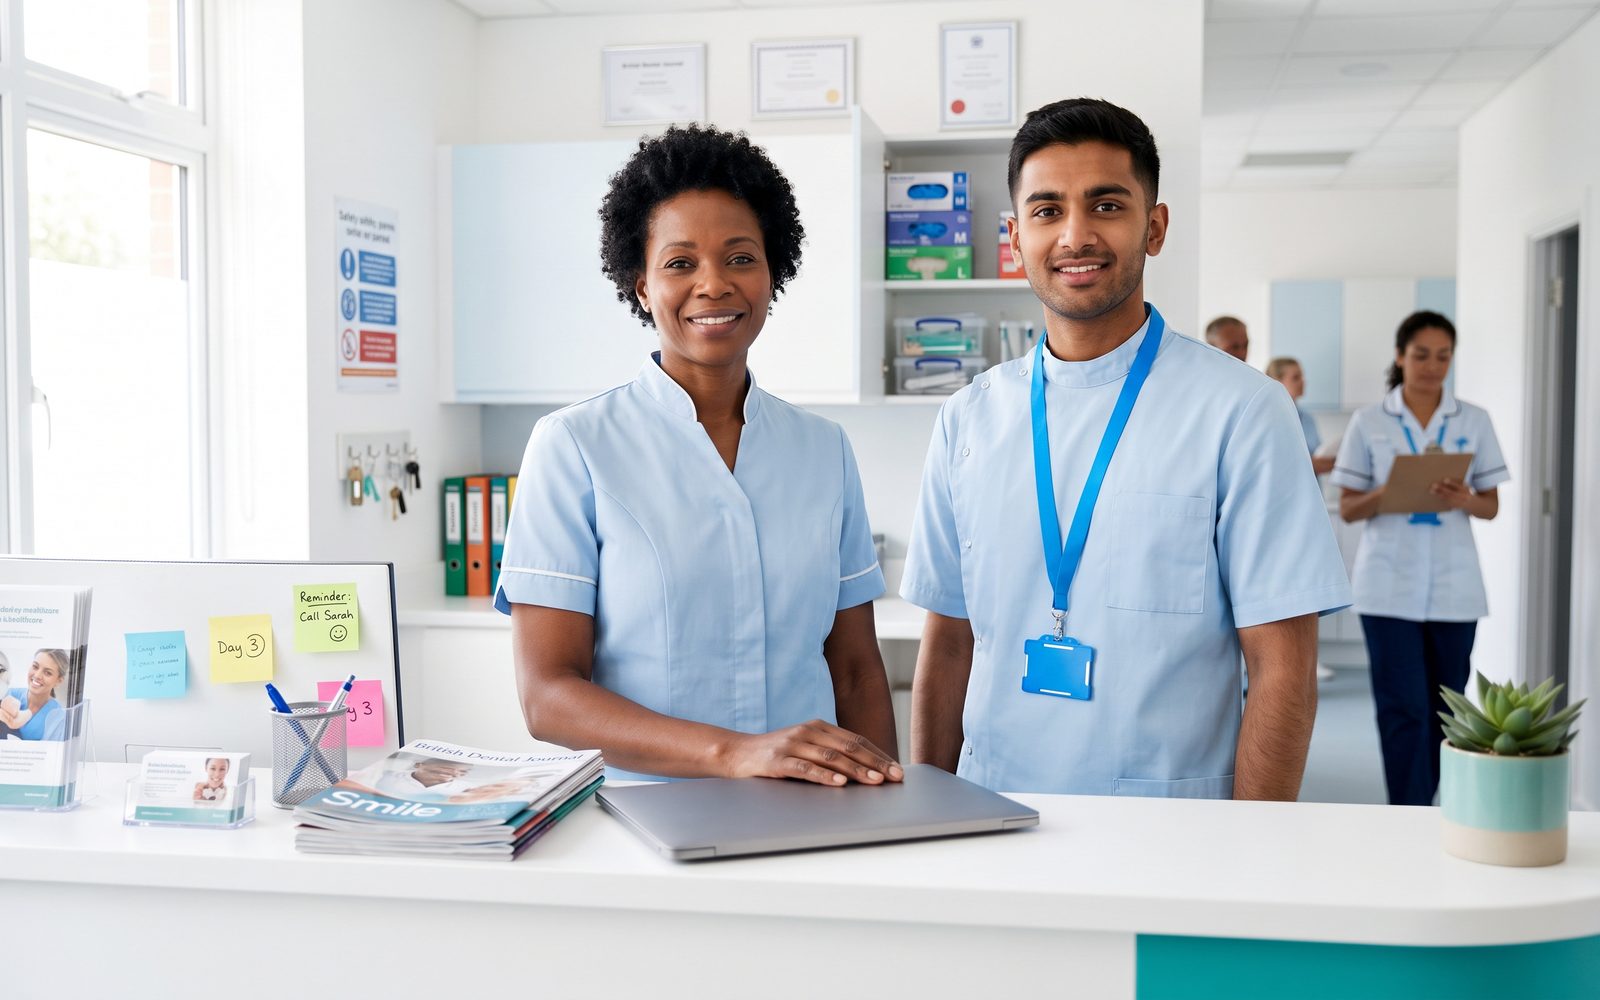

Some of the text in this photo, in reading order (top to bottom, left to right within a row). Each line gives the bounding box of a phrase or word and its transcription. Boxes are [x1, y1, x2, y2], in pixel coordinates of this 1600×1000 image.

[954, 232, 967, 244] M
[957, 267, 967, 279] L
[300, 590, 351, 603] Reminder:
[300, 609, 354, 622] Call Sarah
[217, 638, 259, 659] Day 3
[362, 701, 373, 715] 3
[414, 741, 585, 763] British Dental Journal
[321, 791, 442, 817] Smile
